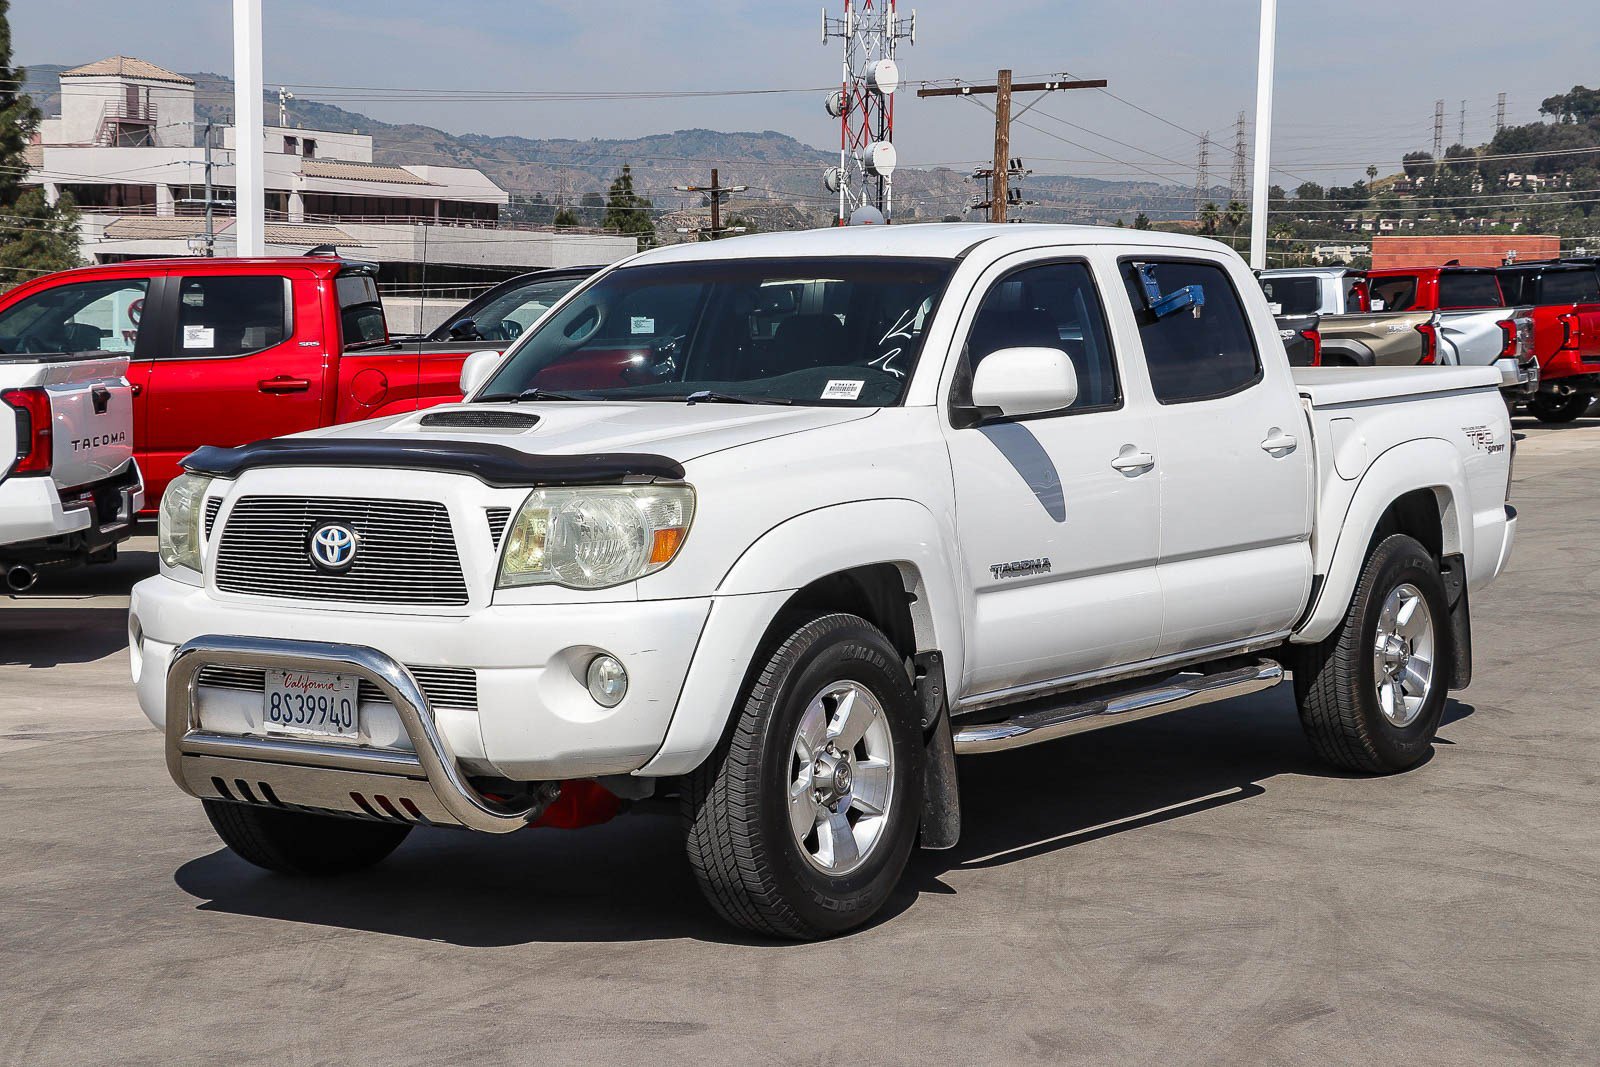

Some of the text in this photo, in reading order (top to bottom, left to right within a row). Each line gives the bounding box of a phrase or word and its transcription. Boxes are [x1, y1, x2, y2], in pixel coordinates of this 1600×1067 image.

[71, 431, 126, 451] TACOMA
[1465, 430, 1494, 450] TRD
[1487, 443, 1505, 455] SPORT
[989, 557, 1051, 579] TACOMA
[284, 673, 341, 693] California
[270, 691, 352, 728] 8S39940
